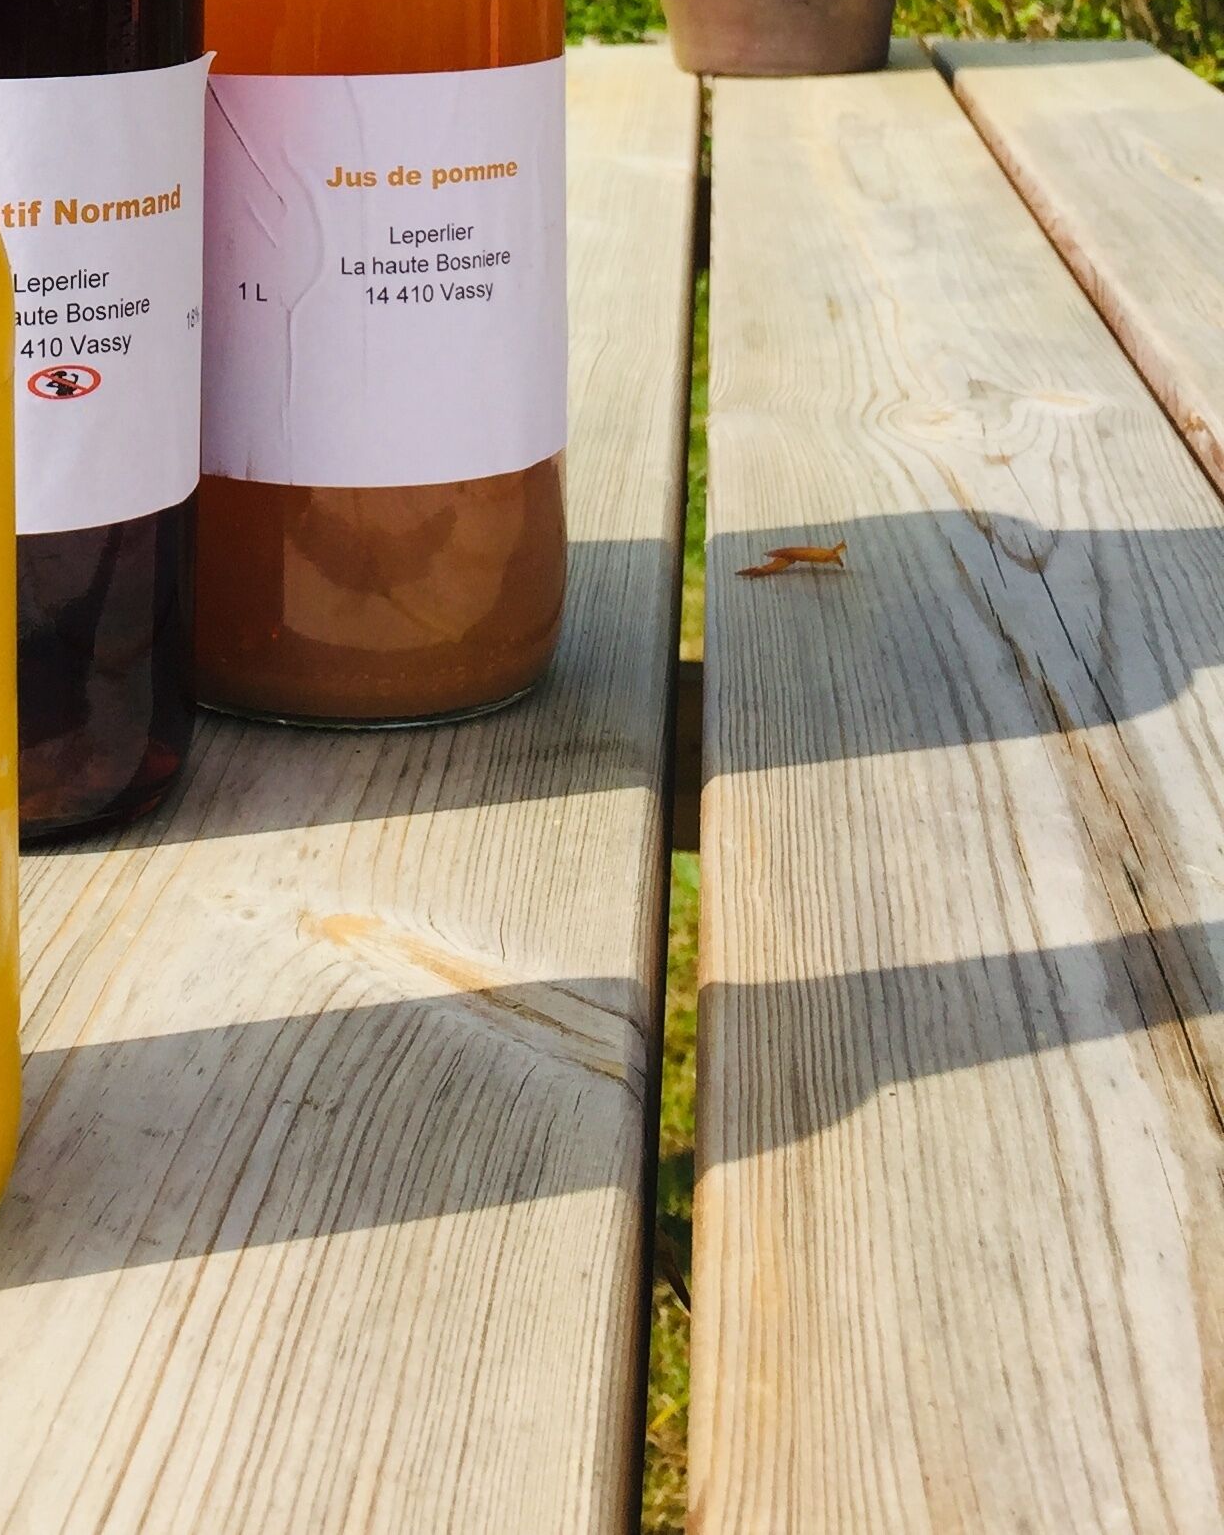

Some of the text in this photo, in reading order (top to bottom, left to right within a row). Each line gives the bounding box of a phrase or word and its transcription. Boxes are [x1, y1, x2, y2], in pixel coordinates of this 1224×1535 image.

[326, 161, 518, 190] Jus de pomme
[54, 183, 181, 226] Normand
[389, 223, 474, 248] Leperlier
[341, 249, 511, 276] La haute Bosniere
[13, 269, 110, 297] Leperlier
[238, 282, 268, 302] 1 L
[365, 281, 494, 305] 14 410 Vassy
[66, 297, 151, 324] Bosniere
[20, 333, 132, 359] 410 Vassy
